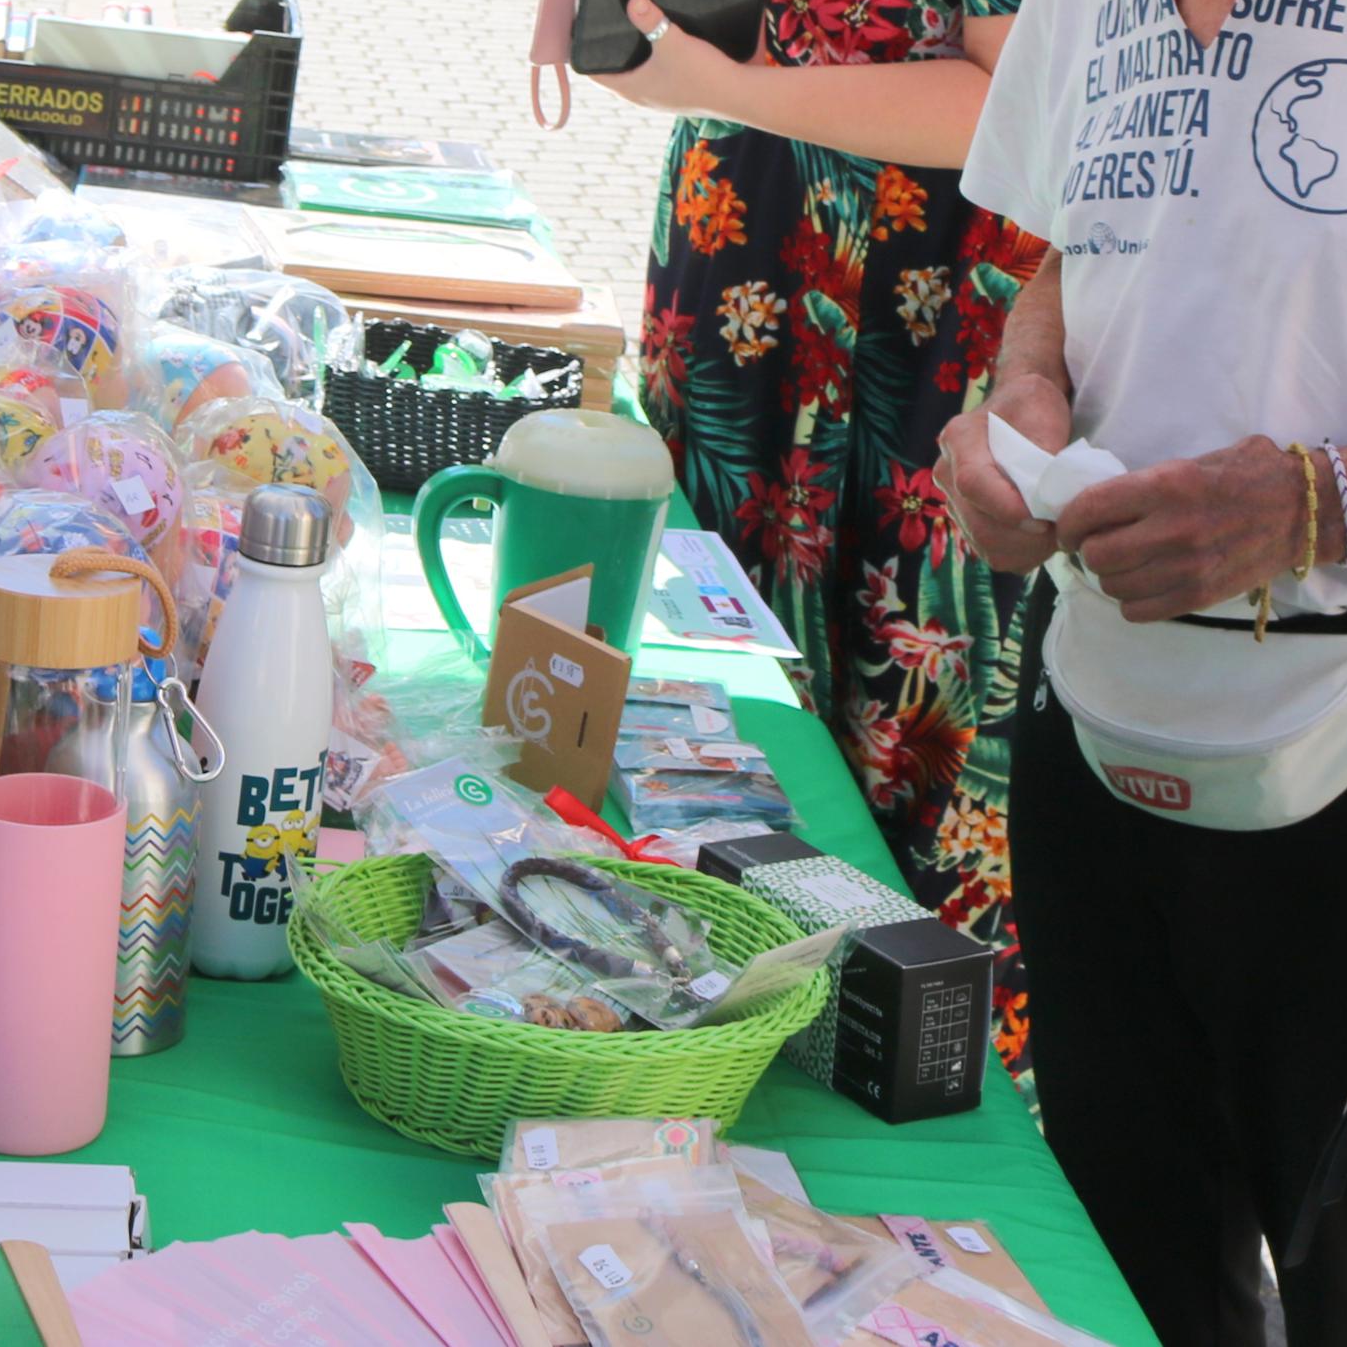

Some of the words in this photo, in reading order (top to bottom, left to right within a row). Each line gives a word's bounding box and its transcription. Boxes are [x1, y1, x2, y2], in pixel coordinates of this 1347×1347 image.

[1086, 55, 1107, 103] EL
[1115, 28, 1253, 94] MALTRATO
[1098, 88, 1210, 146] PLANETA
[1082, 150, 1155, 201] ERES
[1160, 138, 1200, 198] TÚ.
